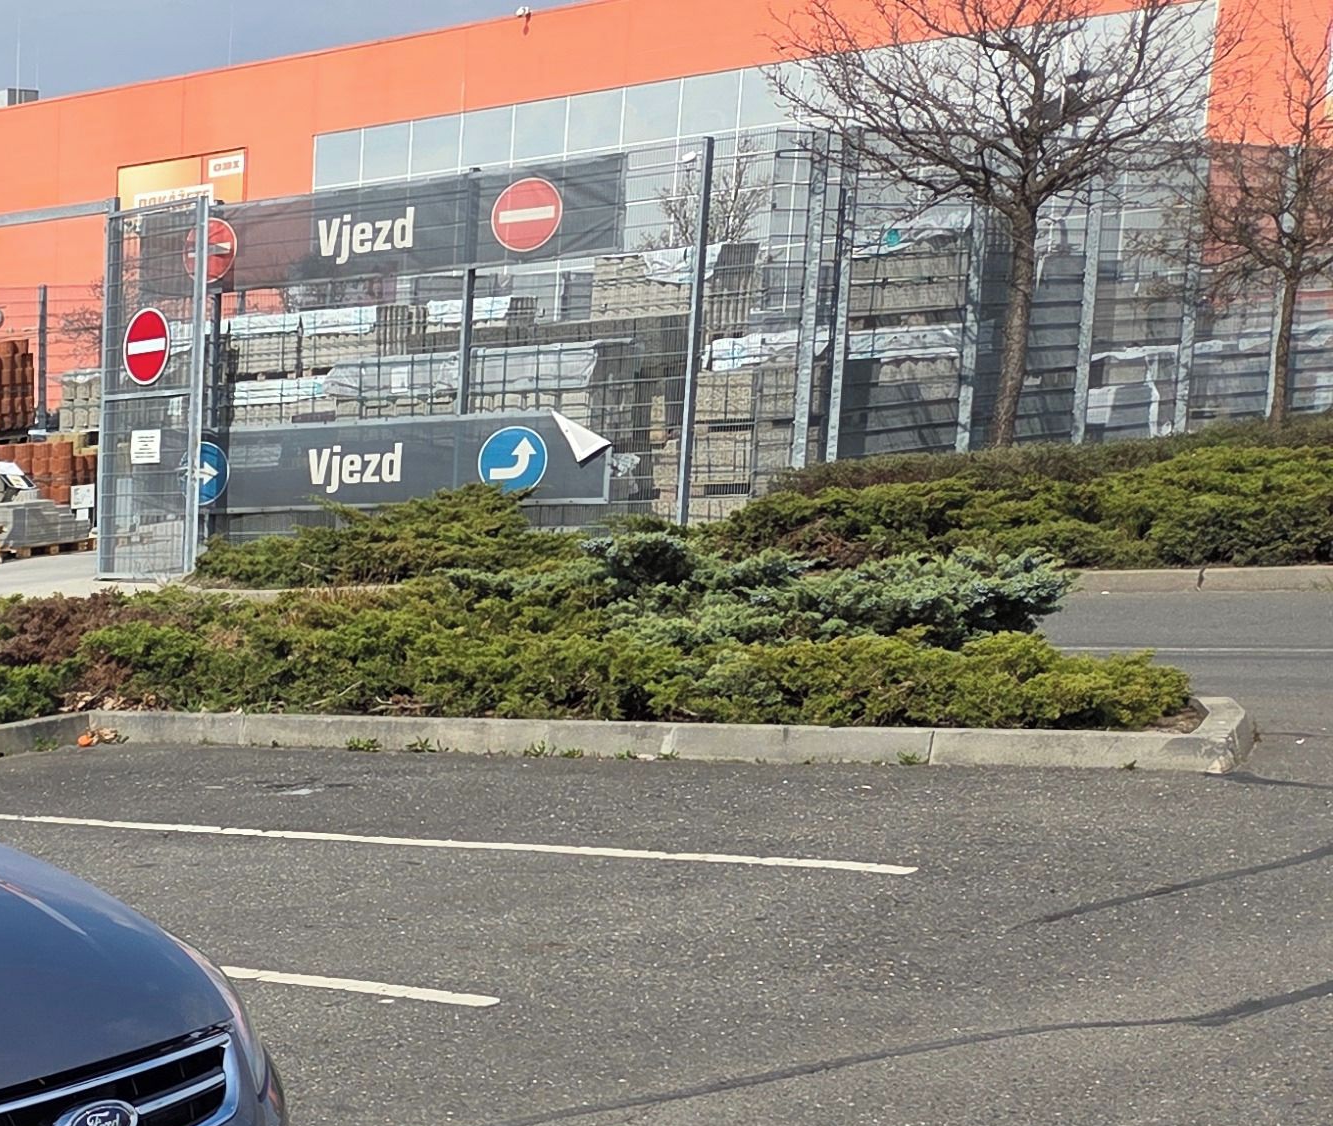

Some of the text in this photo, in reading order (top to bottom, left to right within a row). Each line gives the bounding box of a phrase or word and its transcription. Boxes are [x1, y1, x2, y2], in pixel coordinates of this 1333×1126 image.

[213, 160, 240, 172] OBI
[318, 206, 415, 265] Vjezd
[308, 442, 403, 493] Vjezd
